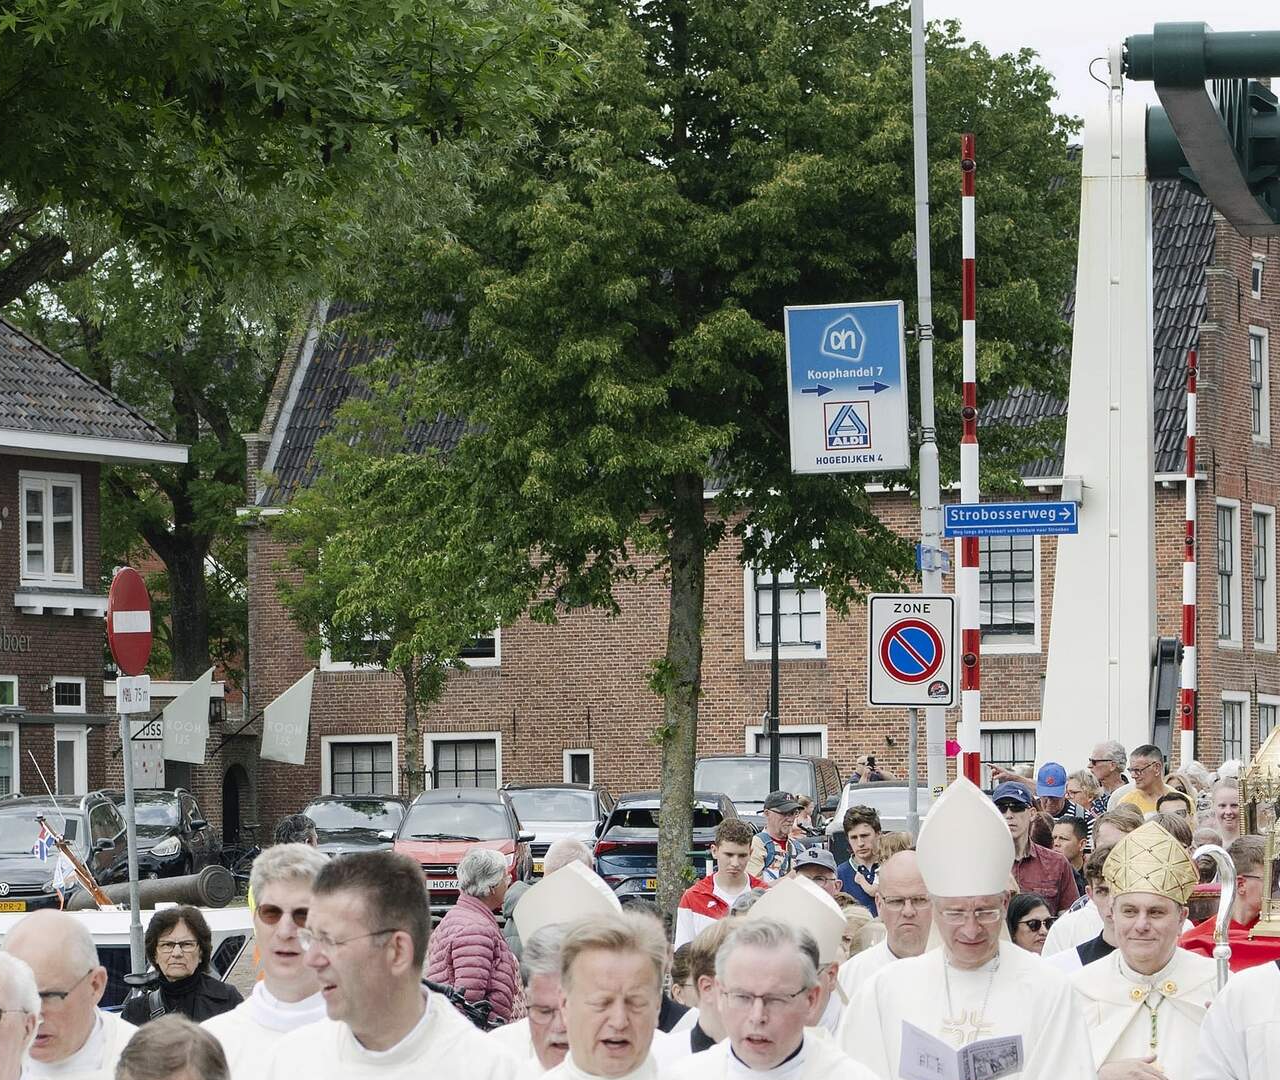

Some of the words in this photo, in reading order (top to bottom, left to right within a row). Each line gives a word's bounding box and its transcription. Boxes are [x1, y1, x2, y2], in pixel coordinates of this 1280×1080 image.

[808, 367, 873, 380] Koophandel
[877, 366, 883, 376] 7
[832, 435, 864, 446] ALDI
[816, 455, 875, 464] HOGEDIJKEN
[950, 508, 1056, 521] Strobosserweg
[894, 603, 931, 613] ZONE
